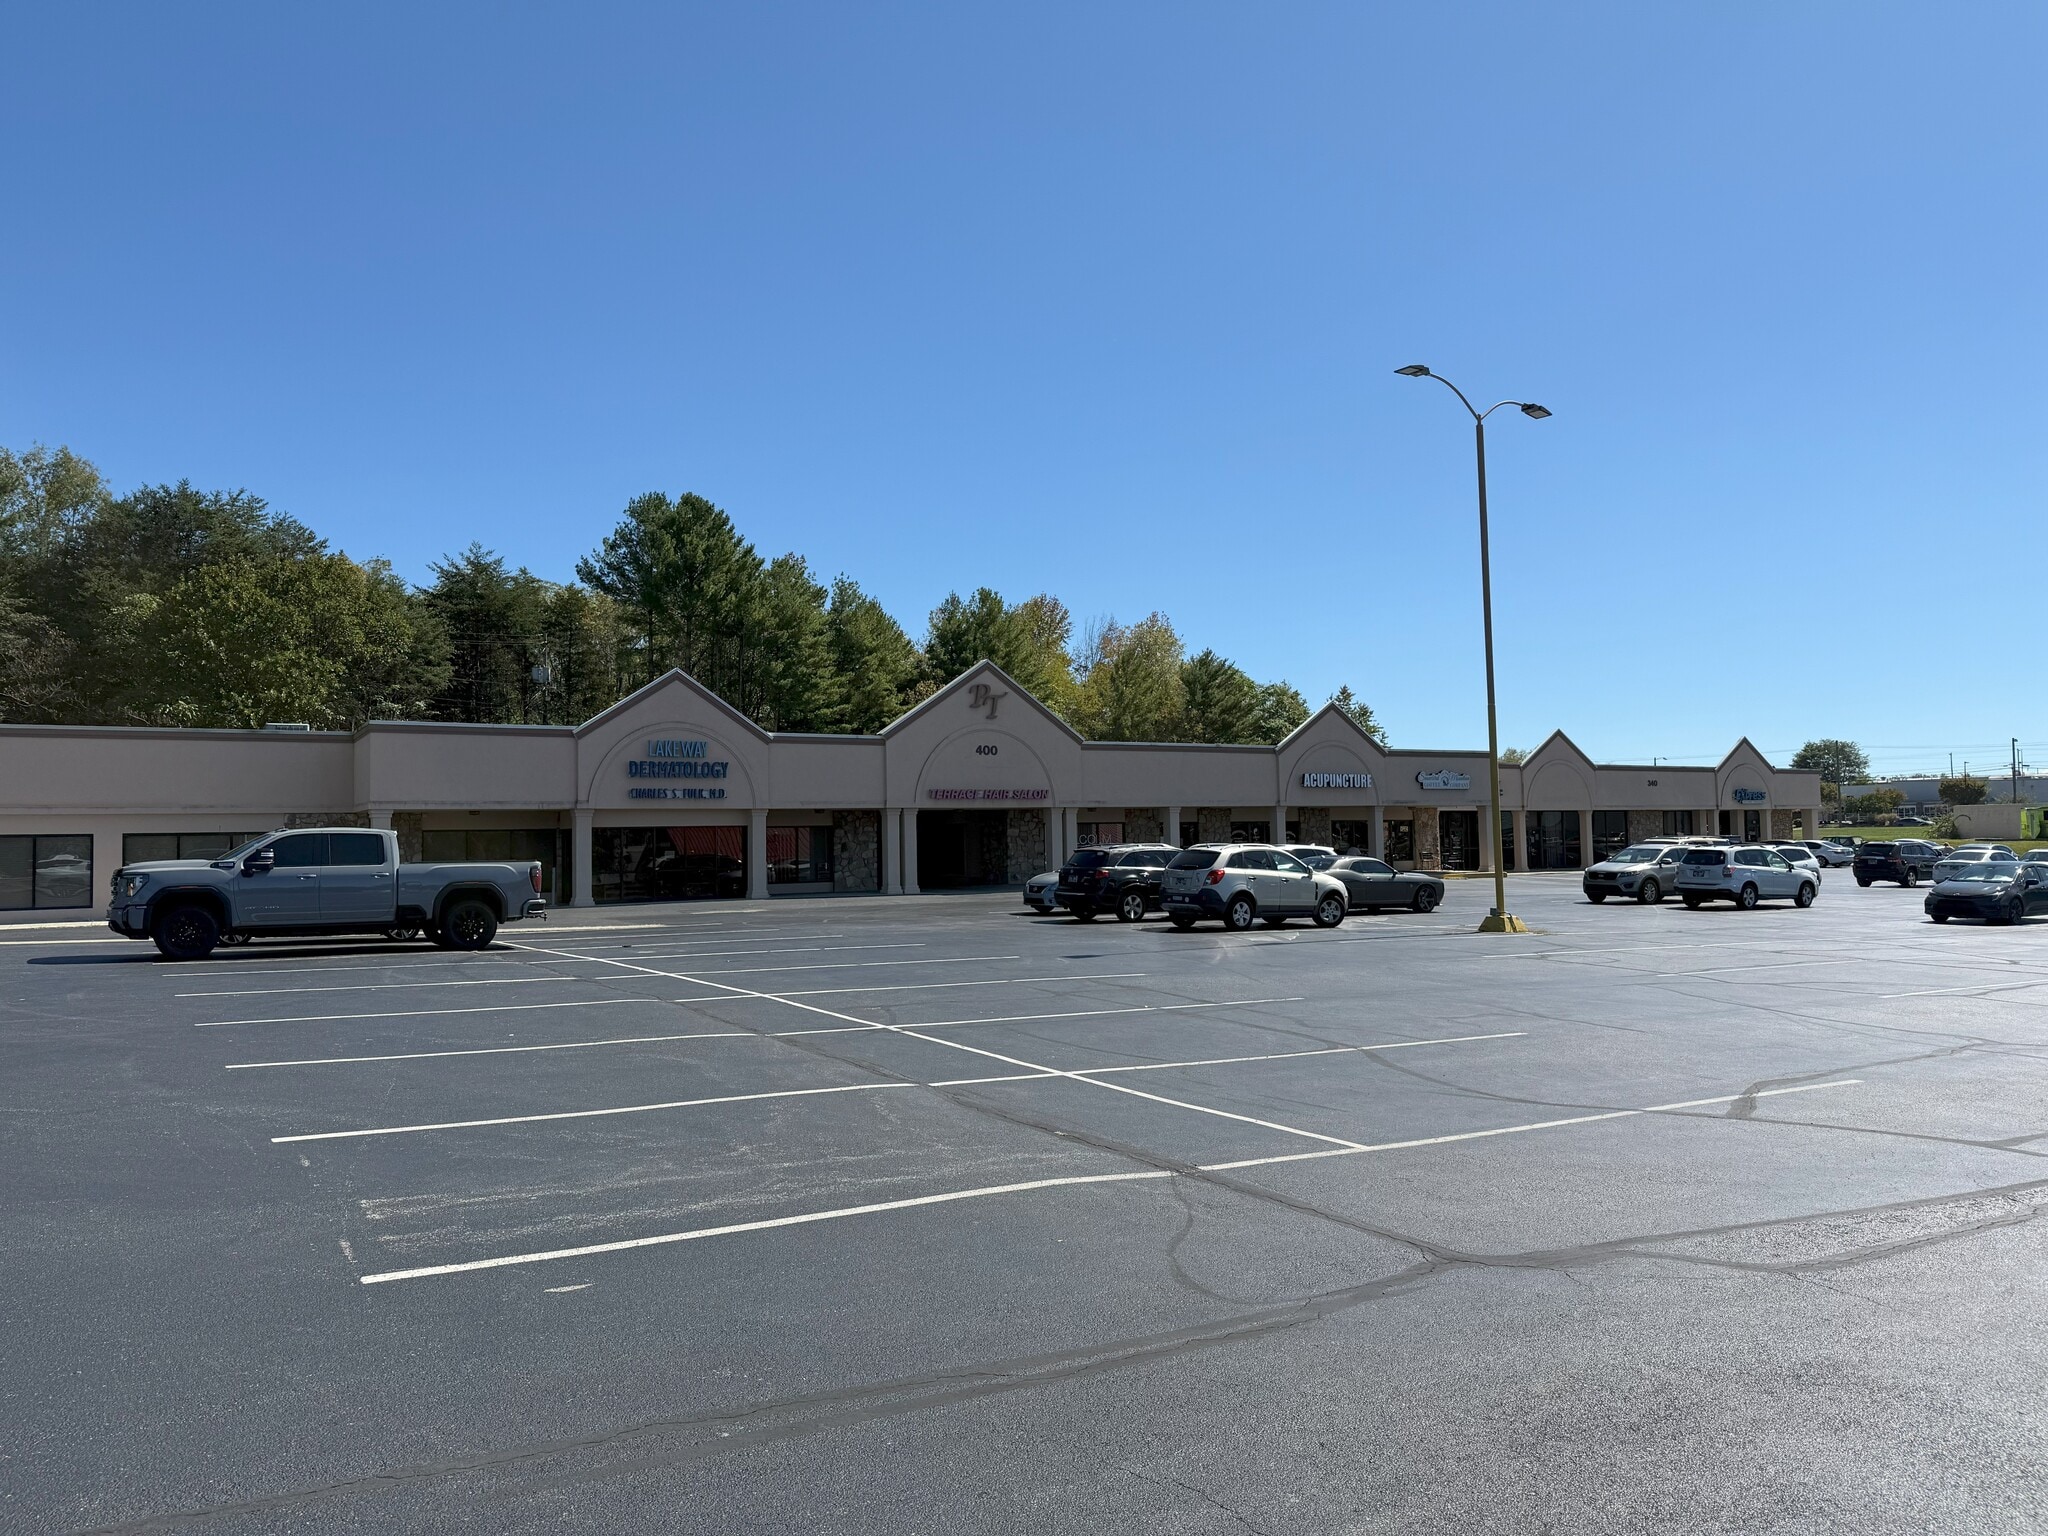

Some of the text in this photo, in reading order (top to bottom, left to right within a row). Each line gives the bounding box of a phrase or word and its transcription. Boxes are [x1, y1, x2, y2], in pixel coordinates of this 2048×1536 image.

[648, 740, 707, 758] LAKEWAY
[975, 745, 998, 756] 400
[628, 760, 729, 779] DERMATOLOGY
[1302, 773, 1372, 788] ACUPUNCTURE
[1647, 779, 1658, 787] 340
[629, 788, 668, 799] CHARLES
[672, 788, 680, 799] S.
[929, 789, 1049, 800] TERRACE HAIR SALON
